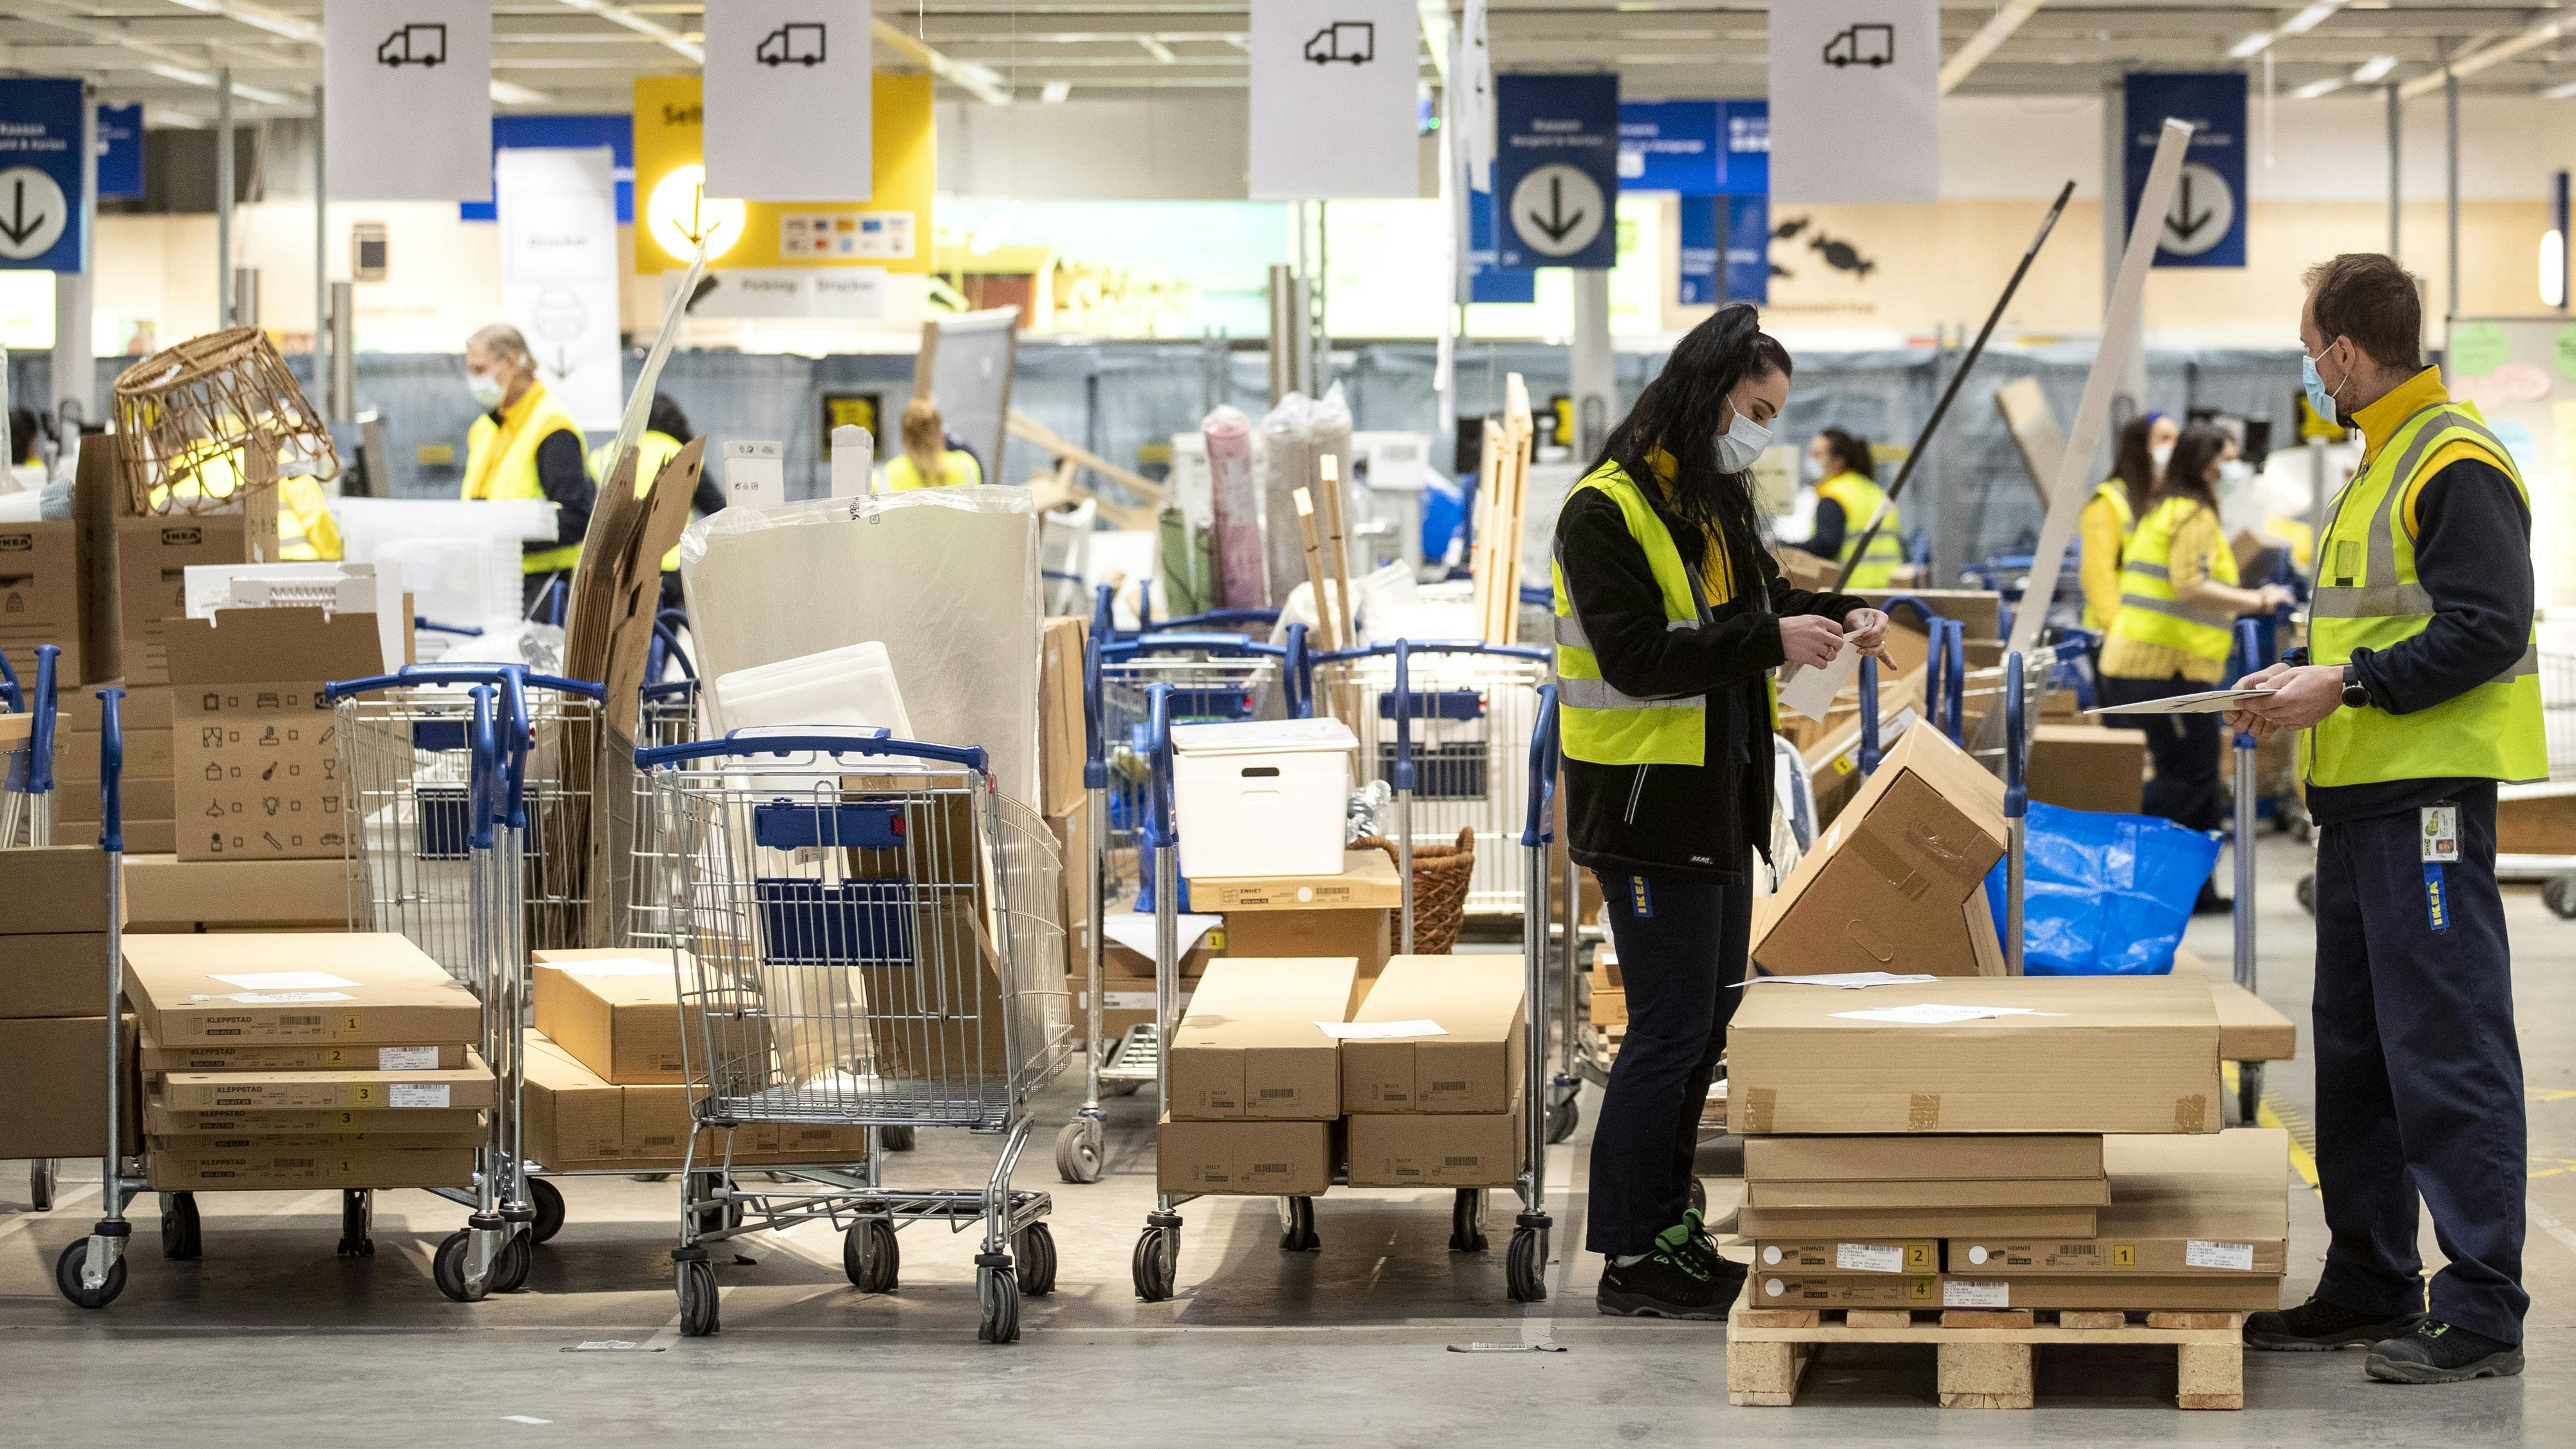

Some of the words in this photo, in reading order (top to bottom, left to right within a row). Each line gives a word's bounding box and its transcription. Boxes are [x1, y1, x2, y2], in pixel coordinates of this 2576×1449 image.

[1634, 876, 1647, 913] IKEA
[2429, 880, 2443, 925] IKEA
[1211, 936, 1218, 946] 1
[348, 1019, 357, 1028] 1
[332, 1051, 341, 1060] 2
[360, 1089, 368, 1099] 3
[343, 1113, 350, 1122] 3
[342, 1161, 350, 1171] 1
[1914, 1249, 1923, 1262] 2
[2121, 1250, 2127, 1262] 1
[1917, 1283, 1925, 1295] 4
